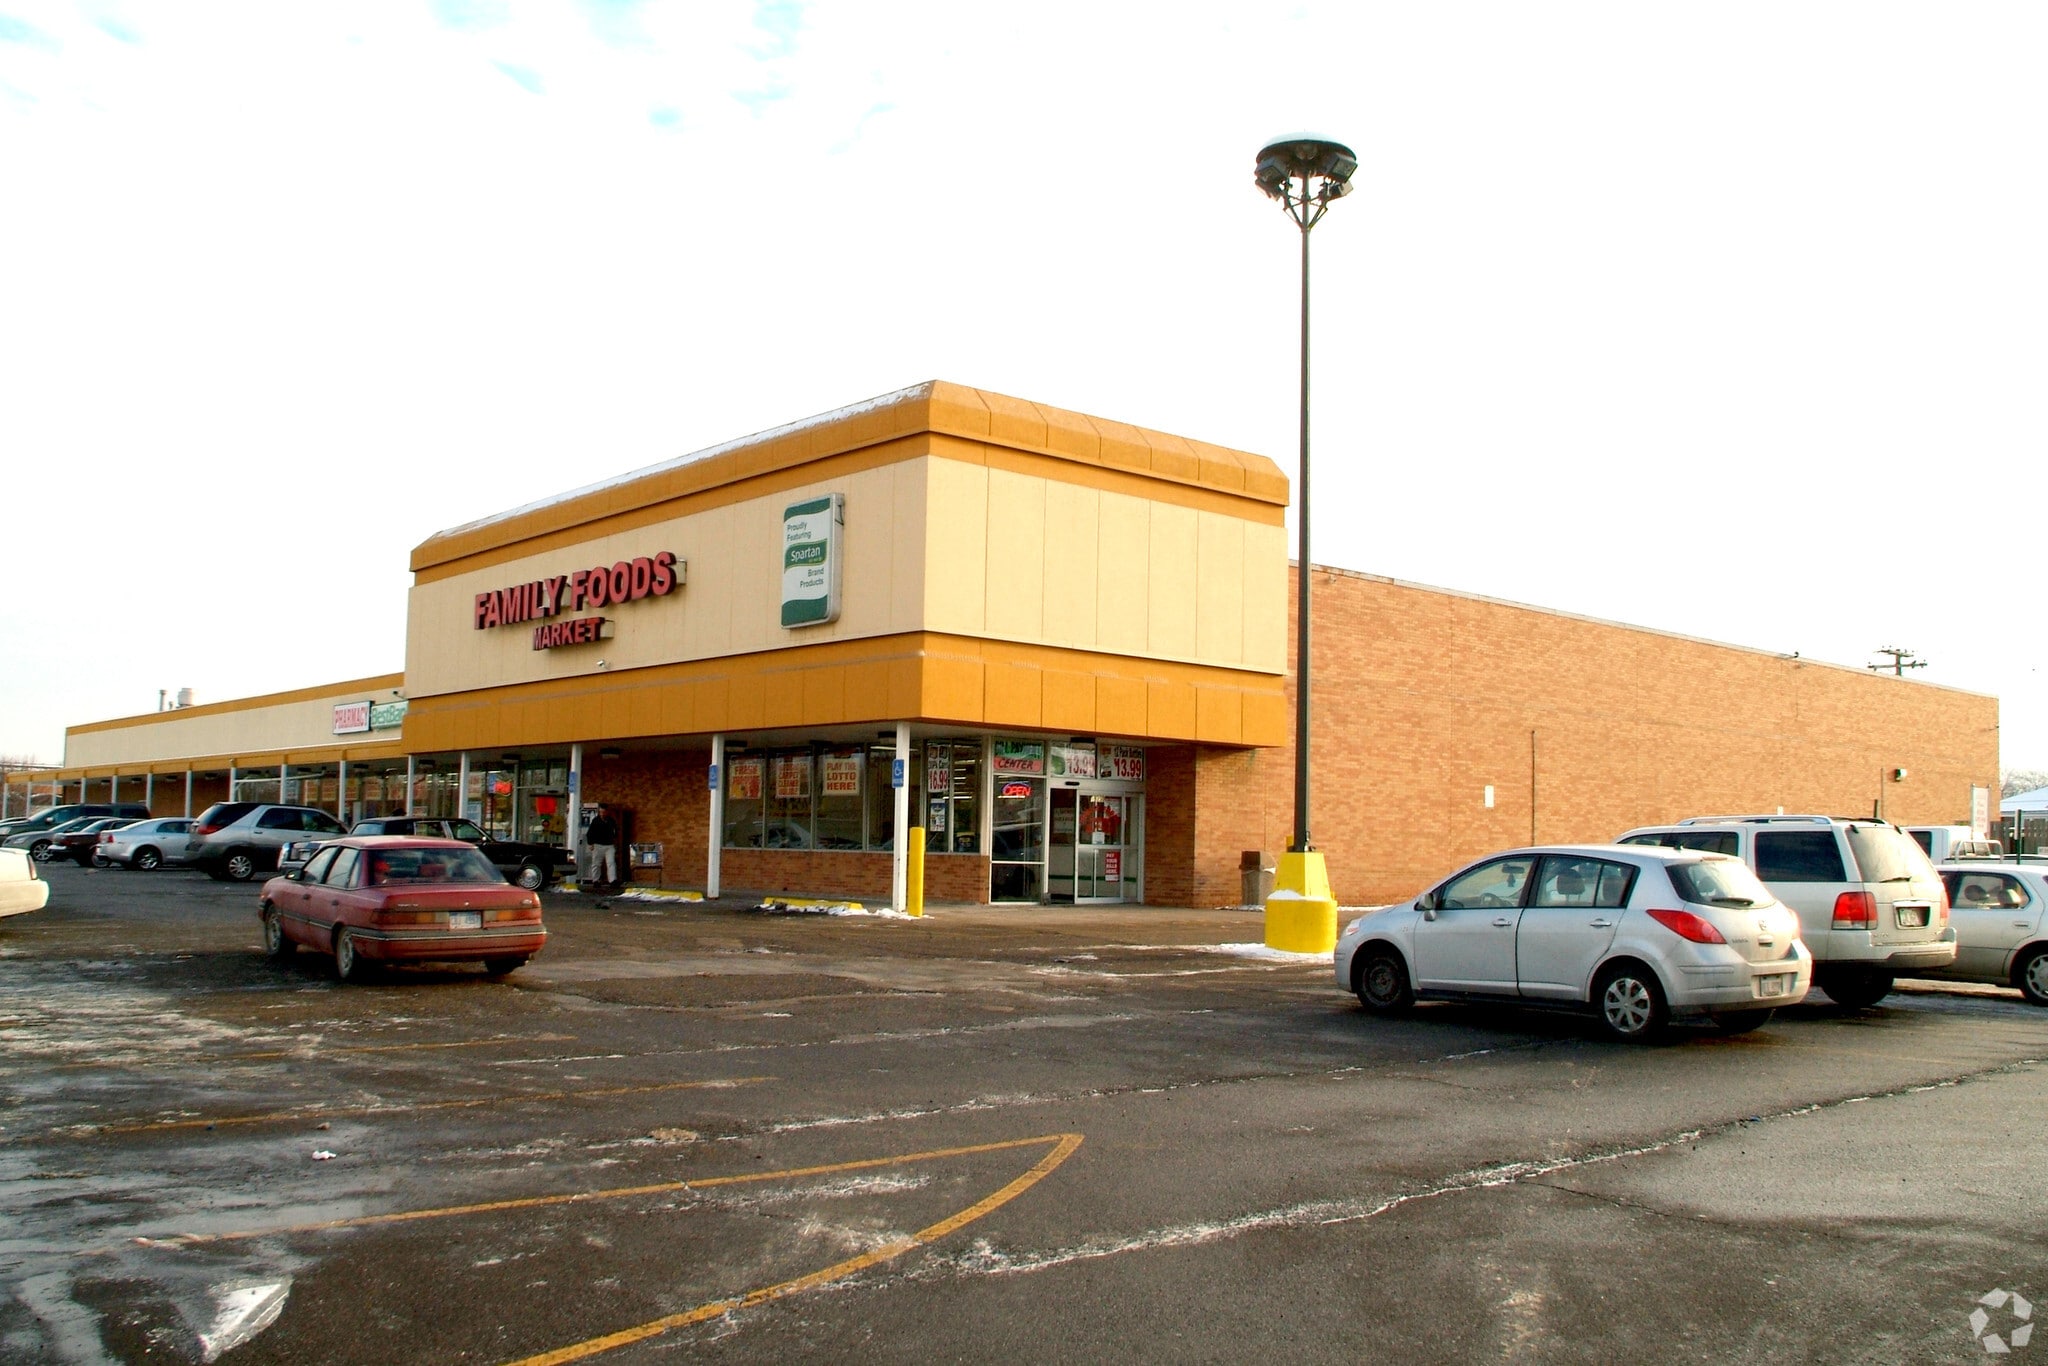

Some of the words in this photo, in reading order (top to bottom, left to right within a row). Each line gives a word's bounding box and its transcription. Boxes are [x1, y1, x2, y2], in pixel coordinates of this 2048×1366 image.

[787, 522, 807, 531] Proudly
[787, 531, 811, 541] Featuring
[791, 546, 820, 562] Spartan
[808, 568, 824, 577] Brand
[800, 579, 824, 588] Products
[475, 575, 568, 630] FAMILY
[571, 551, 676, 611] FOODS
[533, 617, 605, 651] MARKET
[335, 706, 368, 729] PHARMACY
[827, 762, 842, 771] PLAY
[998, 758, 1033, 770] CENTER
[827, 772, 857, 780] LOTTO
[827, 781, 857, 790] HERE!
[1002, 784, 1032, 797] OPEN
